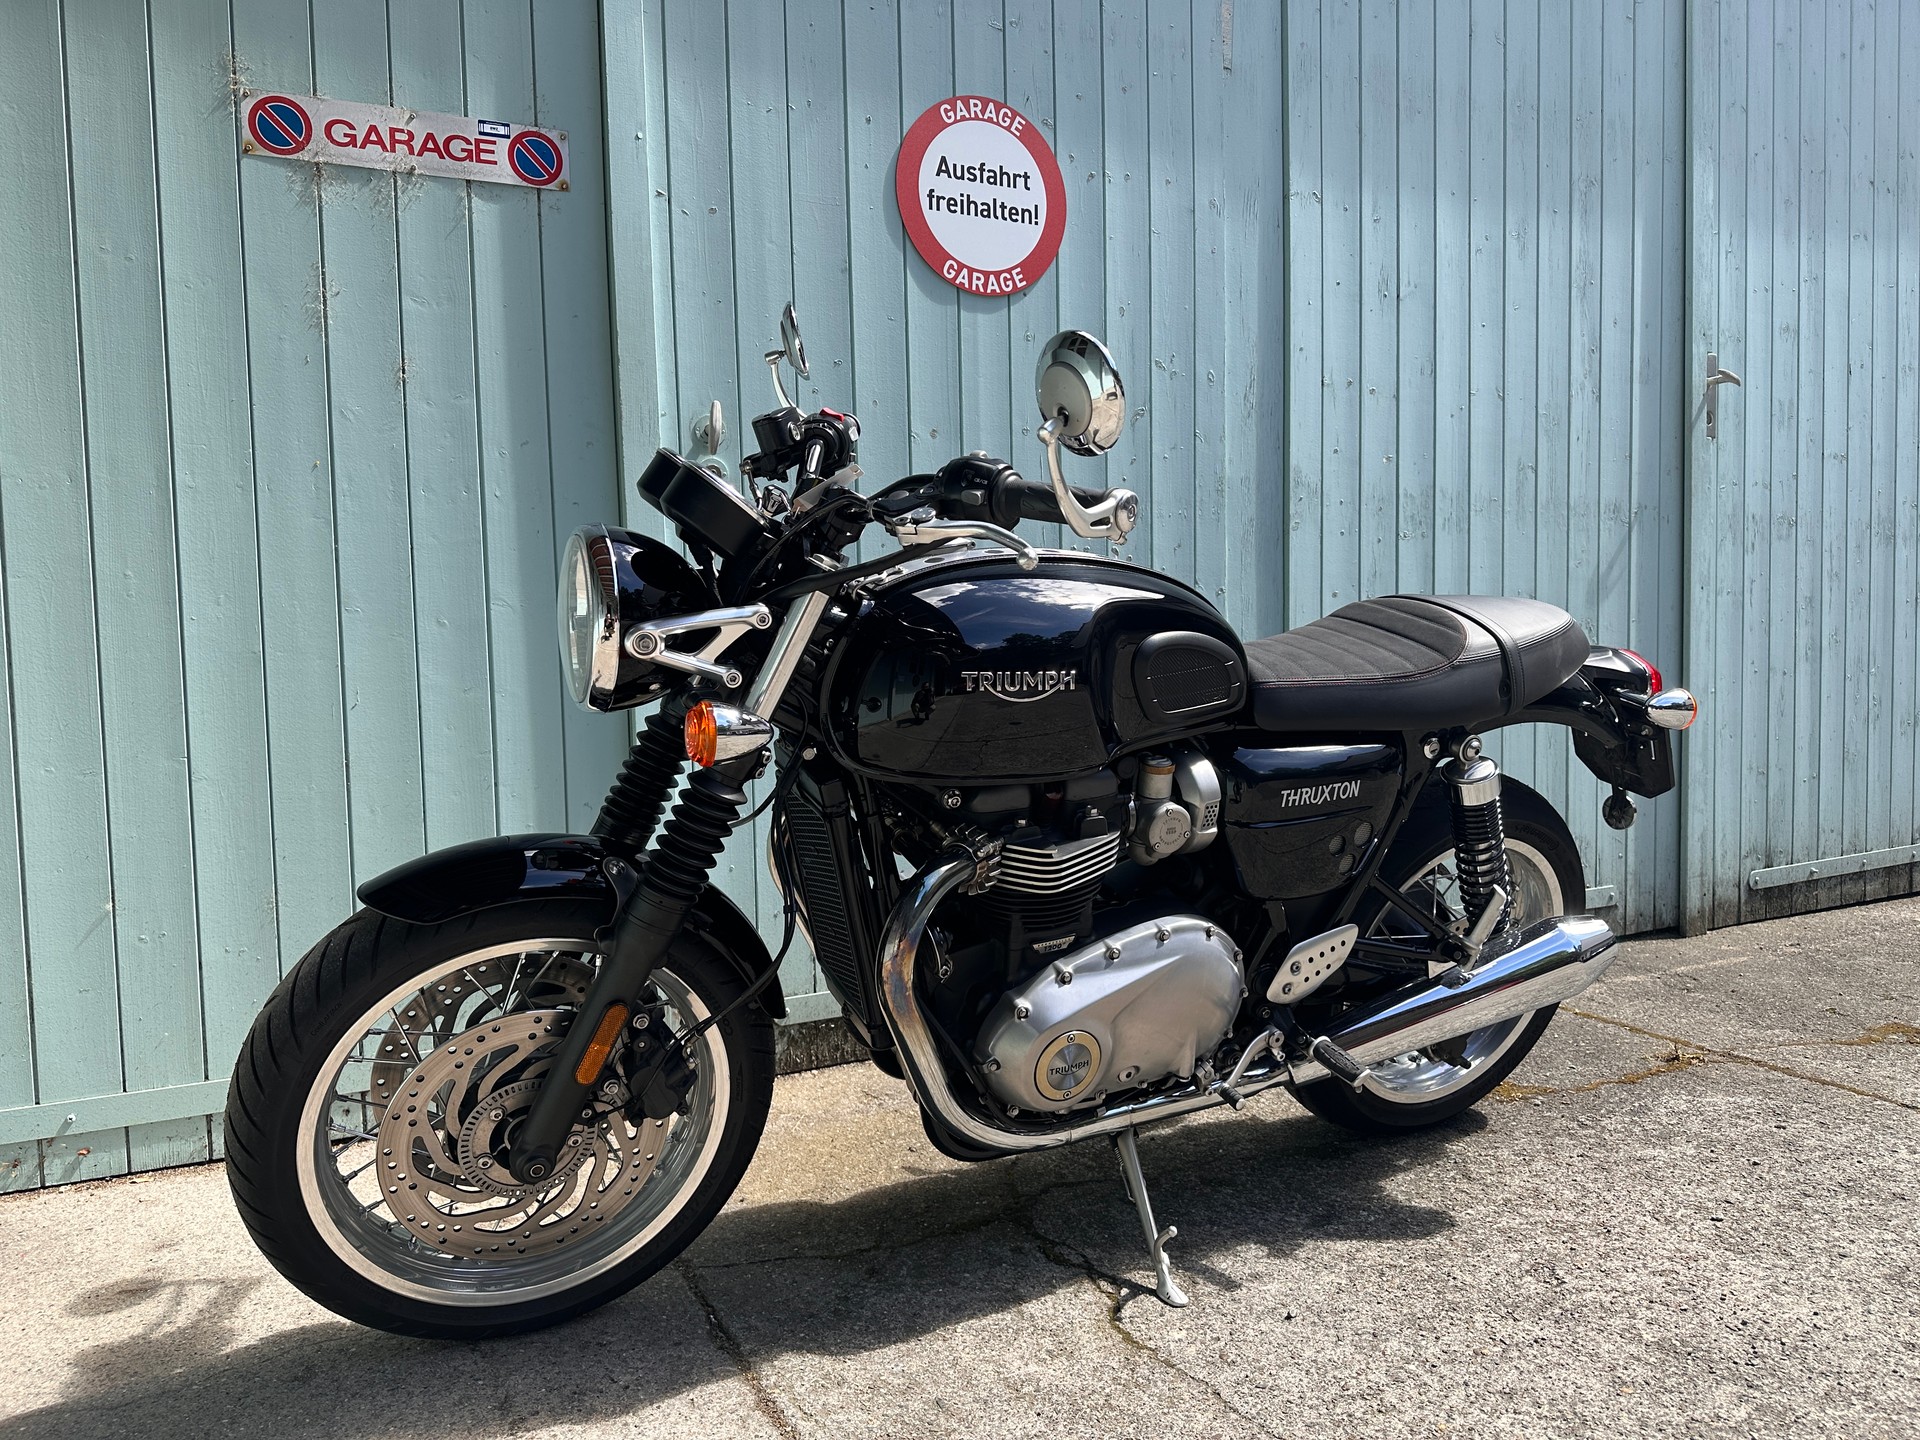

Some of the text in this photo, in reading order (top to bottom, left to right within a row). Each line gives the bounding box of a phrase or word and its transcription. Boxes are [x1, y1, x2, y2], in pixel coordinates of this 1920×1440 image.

[939, 98, 1026, 137] GARAGE
[324, 118, 498, 165] GARAGE
[935, 155, 1031, 191] Ausfahrt
[927, 189, 1039, 226] freihalten!
[942, 259, 1027, 294] GARAGE
[961, 670, 1076, 701] TRIUMPH
[1280, 779, 1361, 808] THRUXTON
[1044, 943, 1062, 952] 1200
[1049, 1059, 1090, 1076] TRIUMPH
